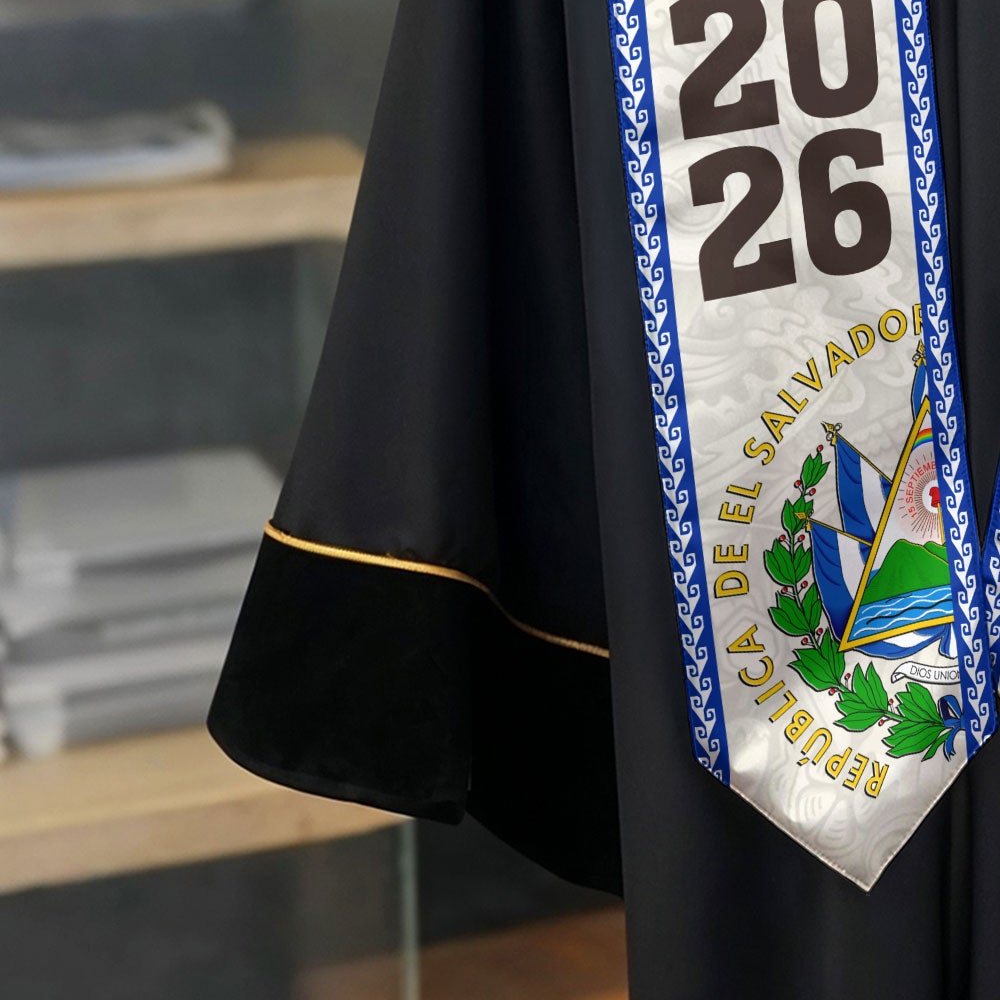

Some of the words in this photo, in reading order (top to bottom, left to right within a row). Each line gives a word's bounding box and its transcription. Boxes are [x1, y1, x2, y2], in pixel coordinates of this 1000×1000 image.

[687, 128, 892, 302] 26
[718, 481, 762, 524] EL
[907, 506, 918, 518] 15
[713, 543, 750, 599] DE
[909, 665, 932, 678] DIOS
[726, 624, 889, 798] REPÚBLICA
